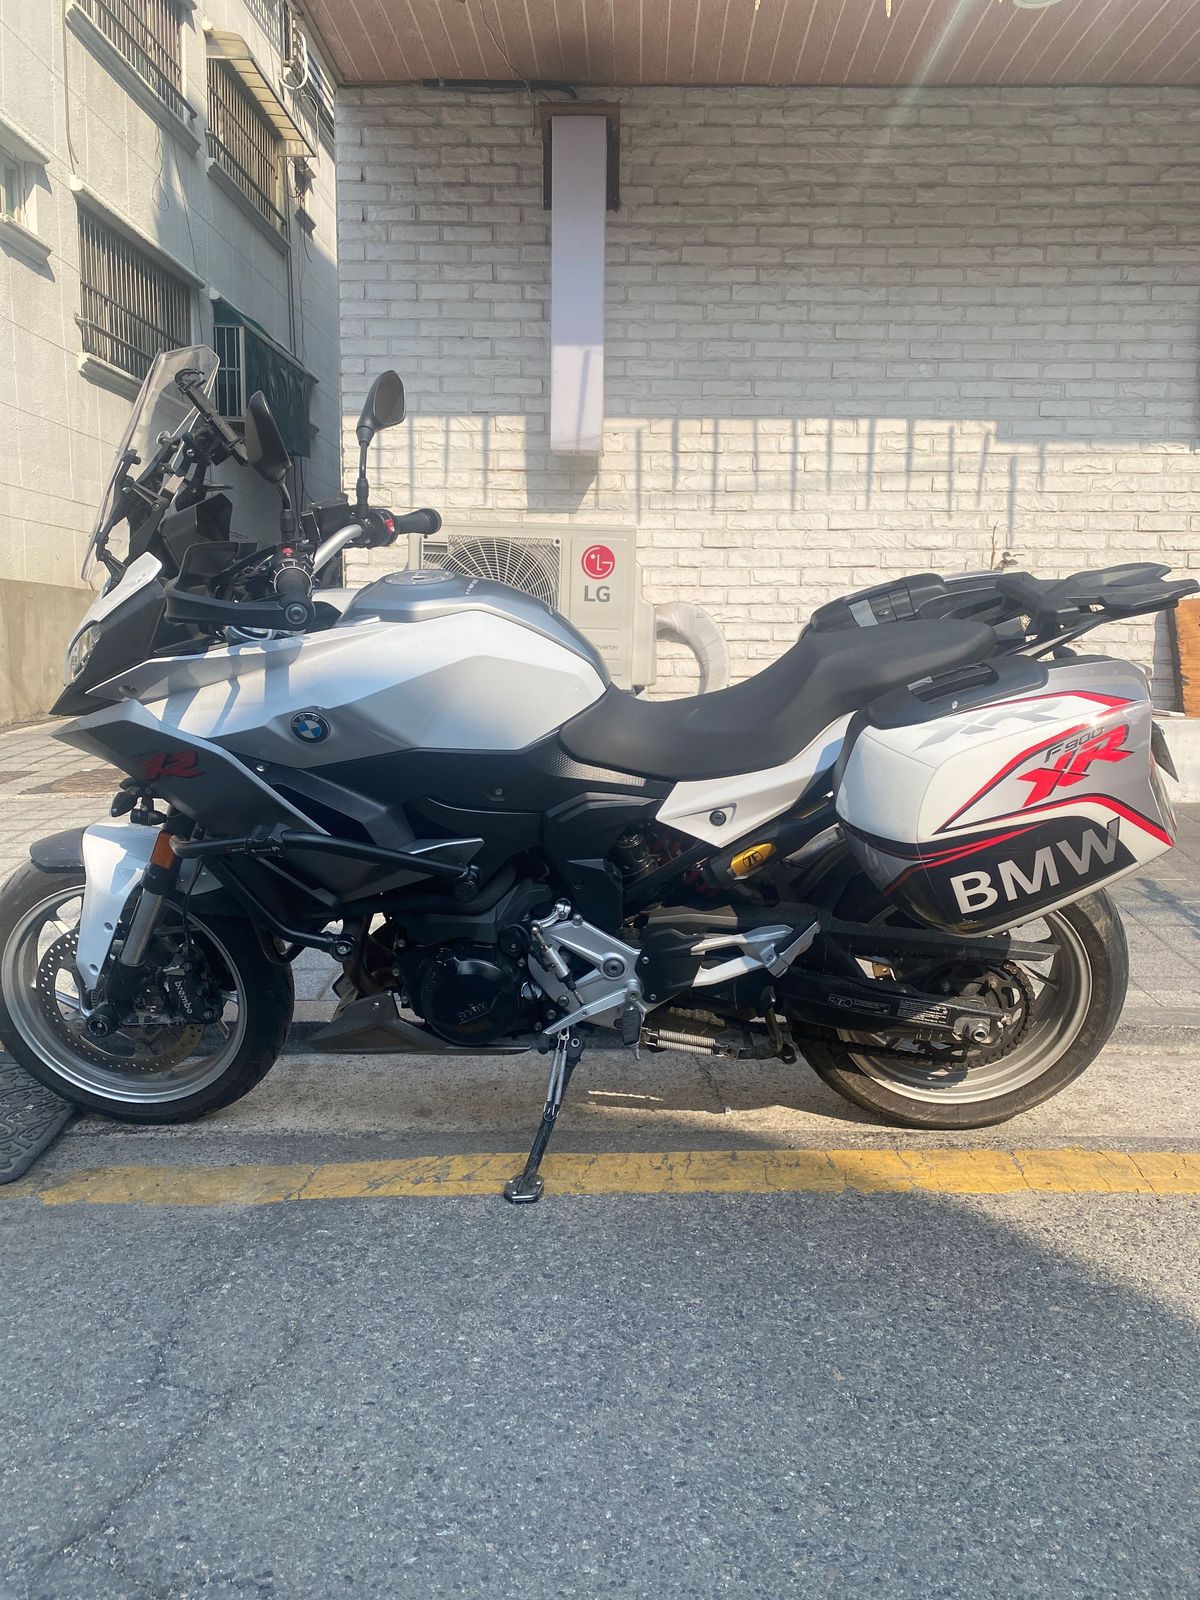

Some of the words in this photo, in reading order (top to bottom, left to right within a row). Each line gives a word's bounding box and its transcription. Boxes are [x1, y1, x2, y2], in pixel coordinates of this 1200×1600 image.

[584, 585, 611, 602] LG
[1016, 724, 1135, 807] XR
[950, 816, 1120, 915] BMW
[174, 980, 193, 1014] brembo
